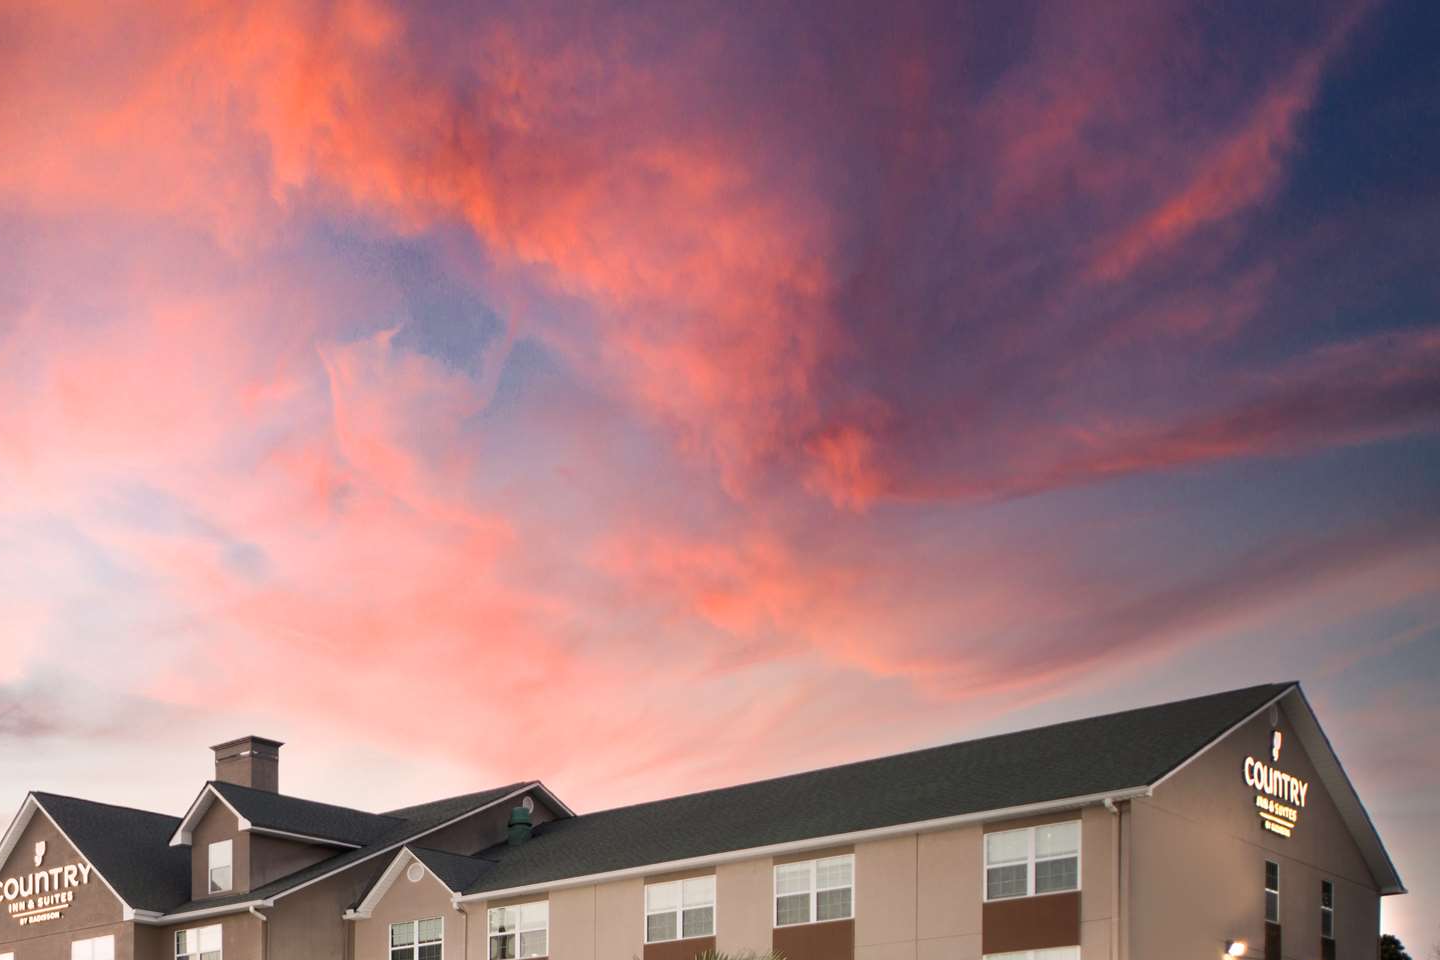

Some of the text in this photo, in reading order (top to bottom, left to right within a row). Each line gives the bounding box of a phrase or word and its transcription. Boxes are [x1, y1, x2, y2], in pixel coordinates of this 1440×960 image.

[8, 891, 73, 913] INN & SUITES
